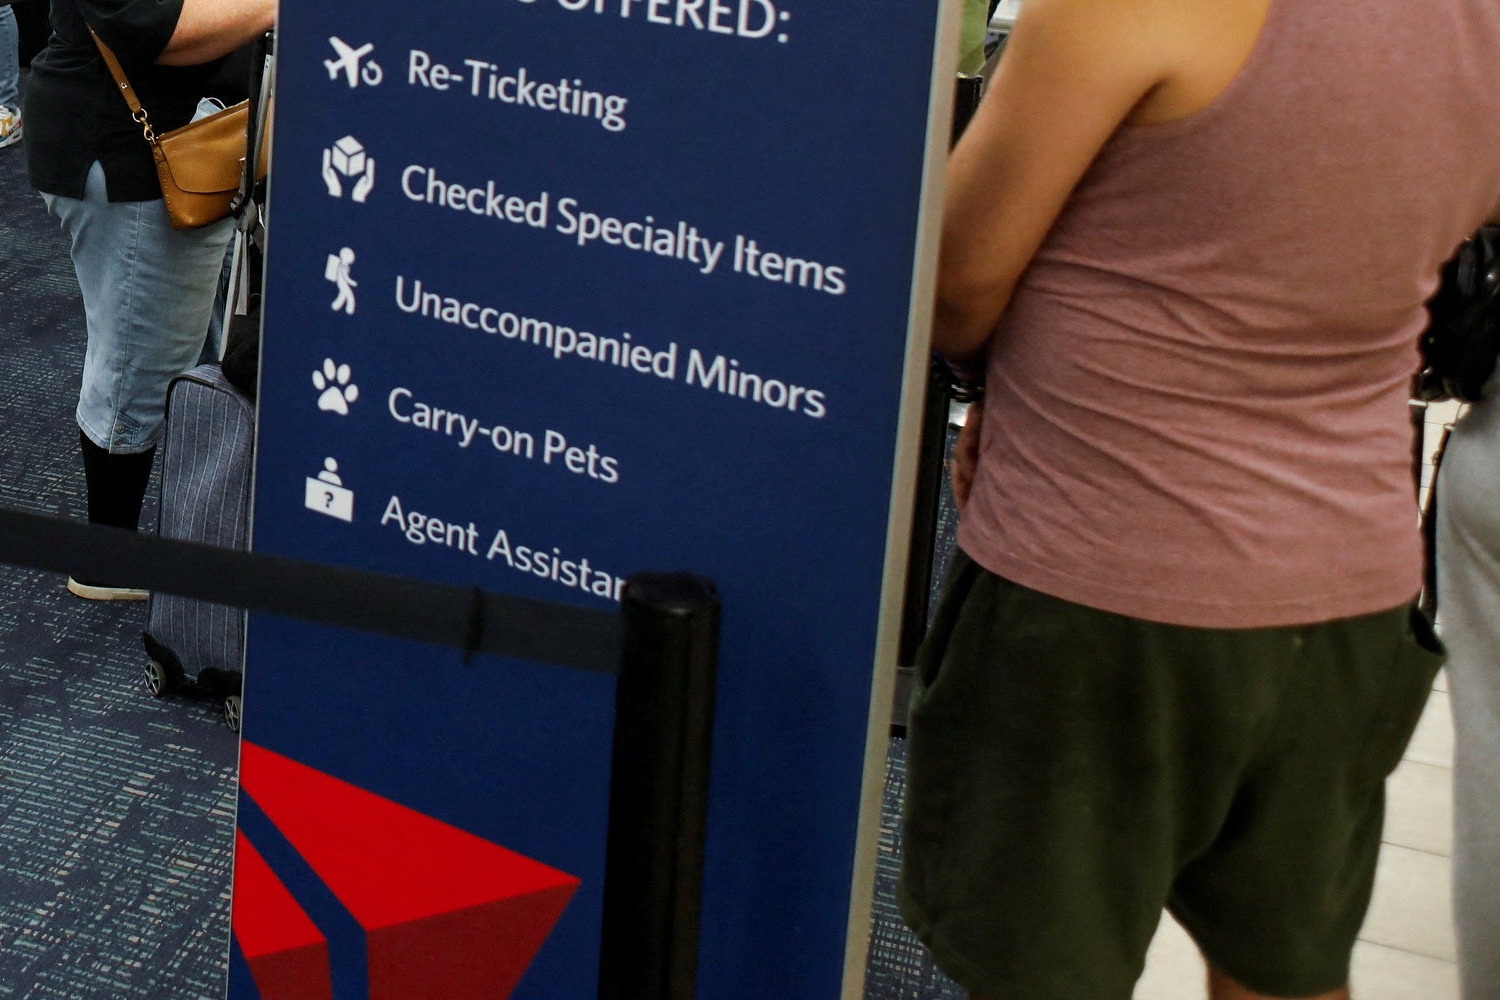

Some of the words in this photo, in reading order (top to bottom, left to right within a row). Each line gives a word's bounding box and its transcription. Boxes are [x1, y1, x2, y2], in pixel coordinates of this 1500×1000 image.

[407, 48, 628, 133] Re-Ticketing
[400, 163, 549, 229] Checked
[555, 196, 725, 275] Specialty
[733, 234, 847, 296] Items
[394, 274, 678, 380] Unaccompanied
[684, 348, 827, 419] Minors
[387, 386, 535, 460] Carry-on
[542, 428, 619, 484] Pets
[380, 494, 480, 556] Agent
